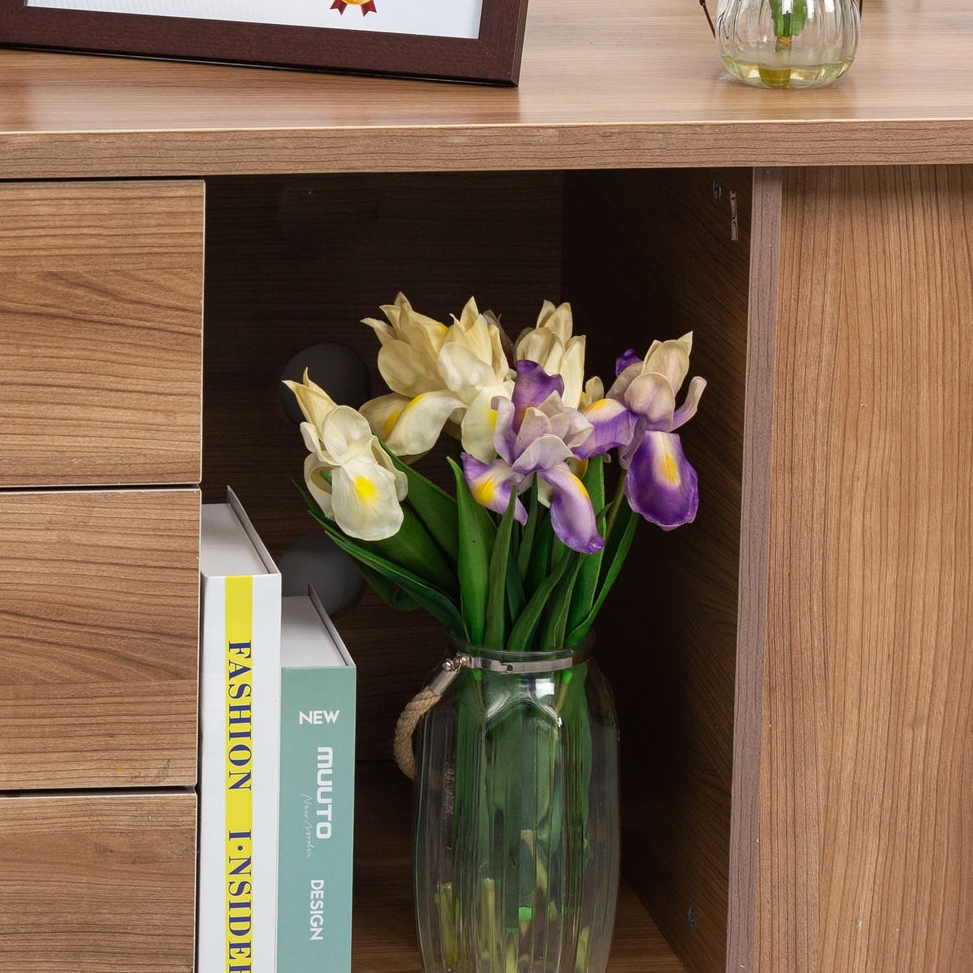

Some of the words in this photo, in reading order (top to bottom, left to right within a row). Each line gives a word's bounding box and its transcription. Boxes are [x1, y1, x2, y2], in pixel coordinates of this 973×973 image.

[228, 641, 252, 792] FASHION
[299, 710, 340, 724] NEW
[310, 879, 324, 940] DESIGN
